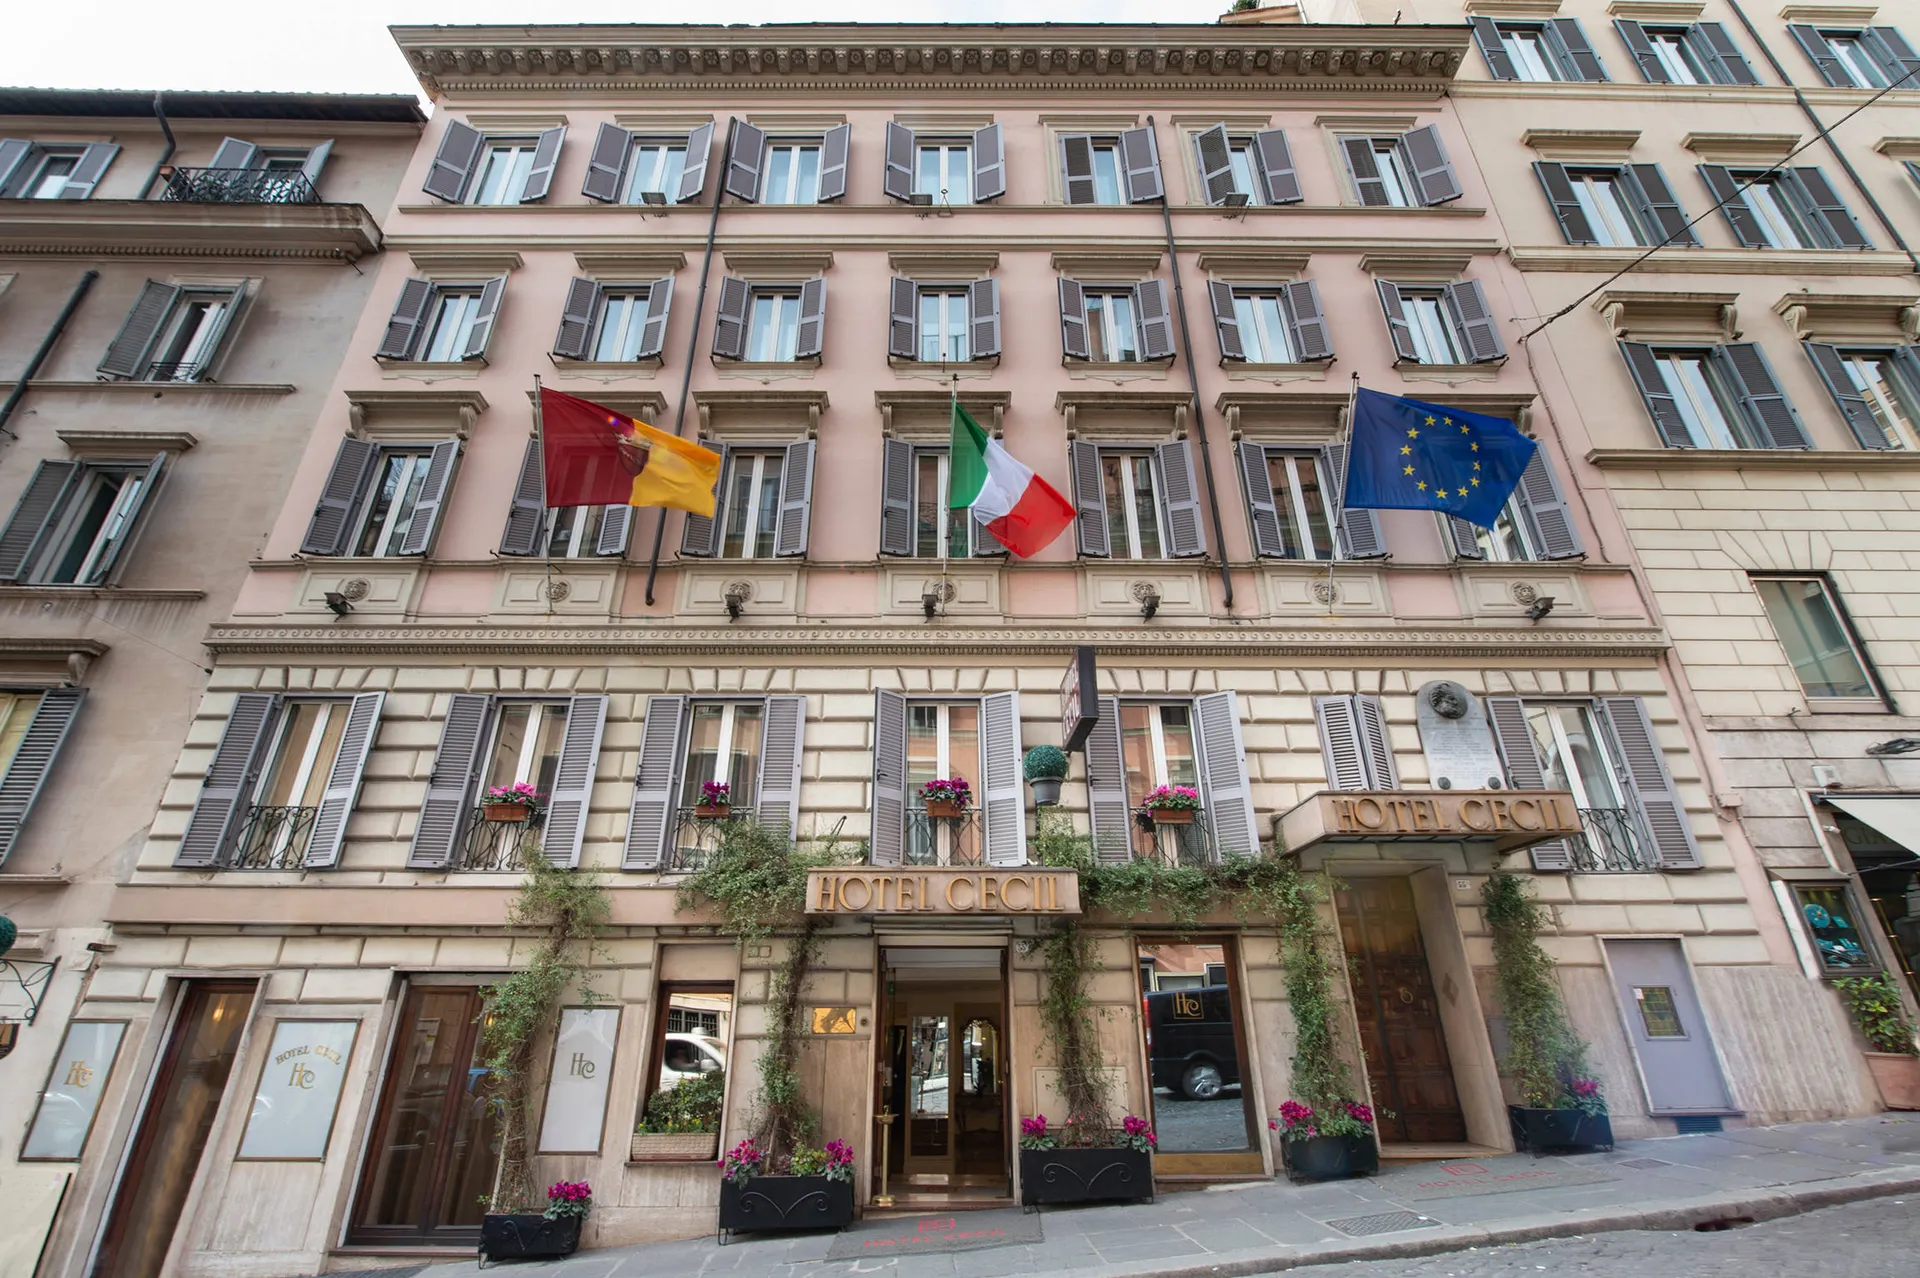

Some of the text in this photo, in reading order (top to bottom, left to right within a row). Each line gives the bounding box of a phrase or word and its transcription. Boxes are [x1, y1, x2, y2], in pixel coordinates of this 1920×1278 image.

[1332, 798, 1576, 832] HOTEL CECIL
[814, 875, 1065, 911] HOTEL CECIL
[275, 1044, 342, 1066] HOTEL CECIL
[1417, 1177, 1487, 1189] HOTEL
[864, 1229, 1007, 1248] HOTEL CECIL
